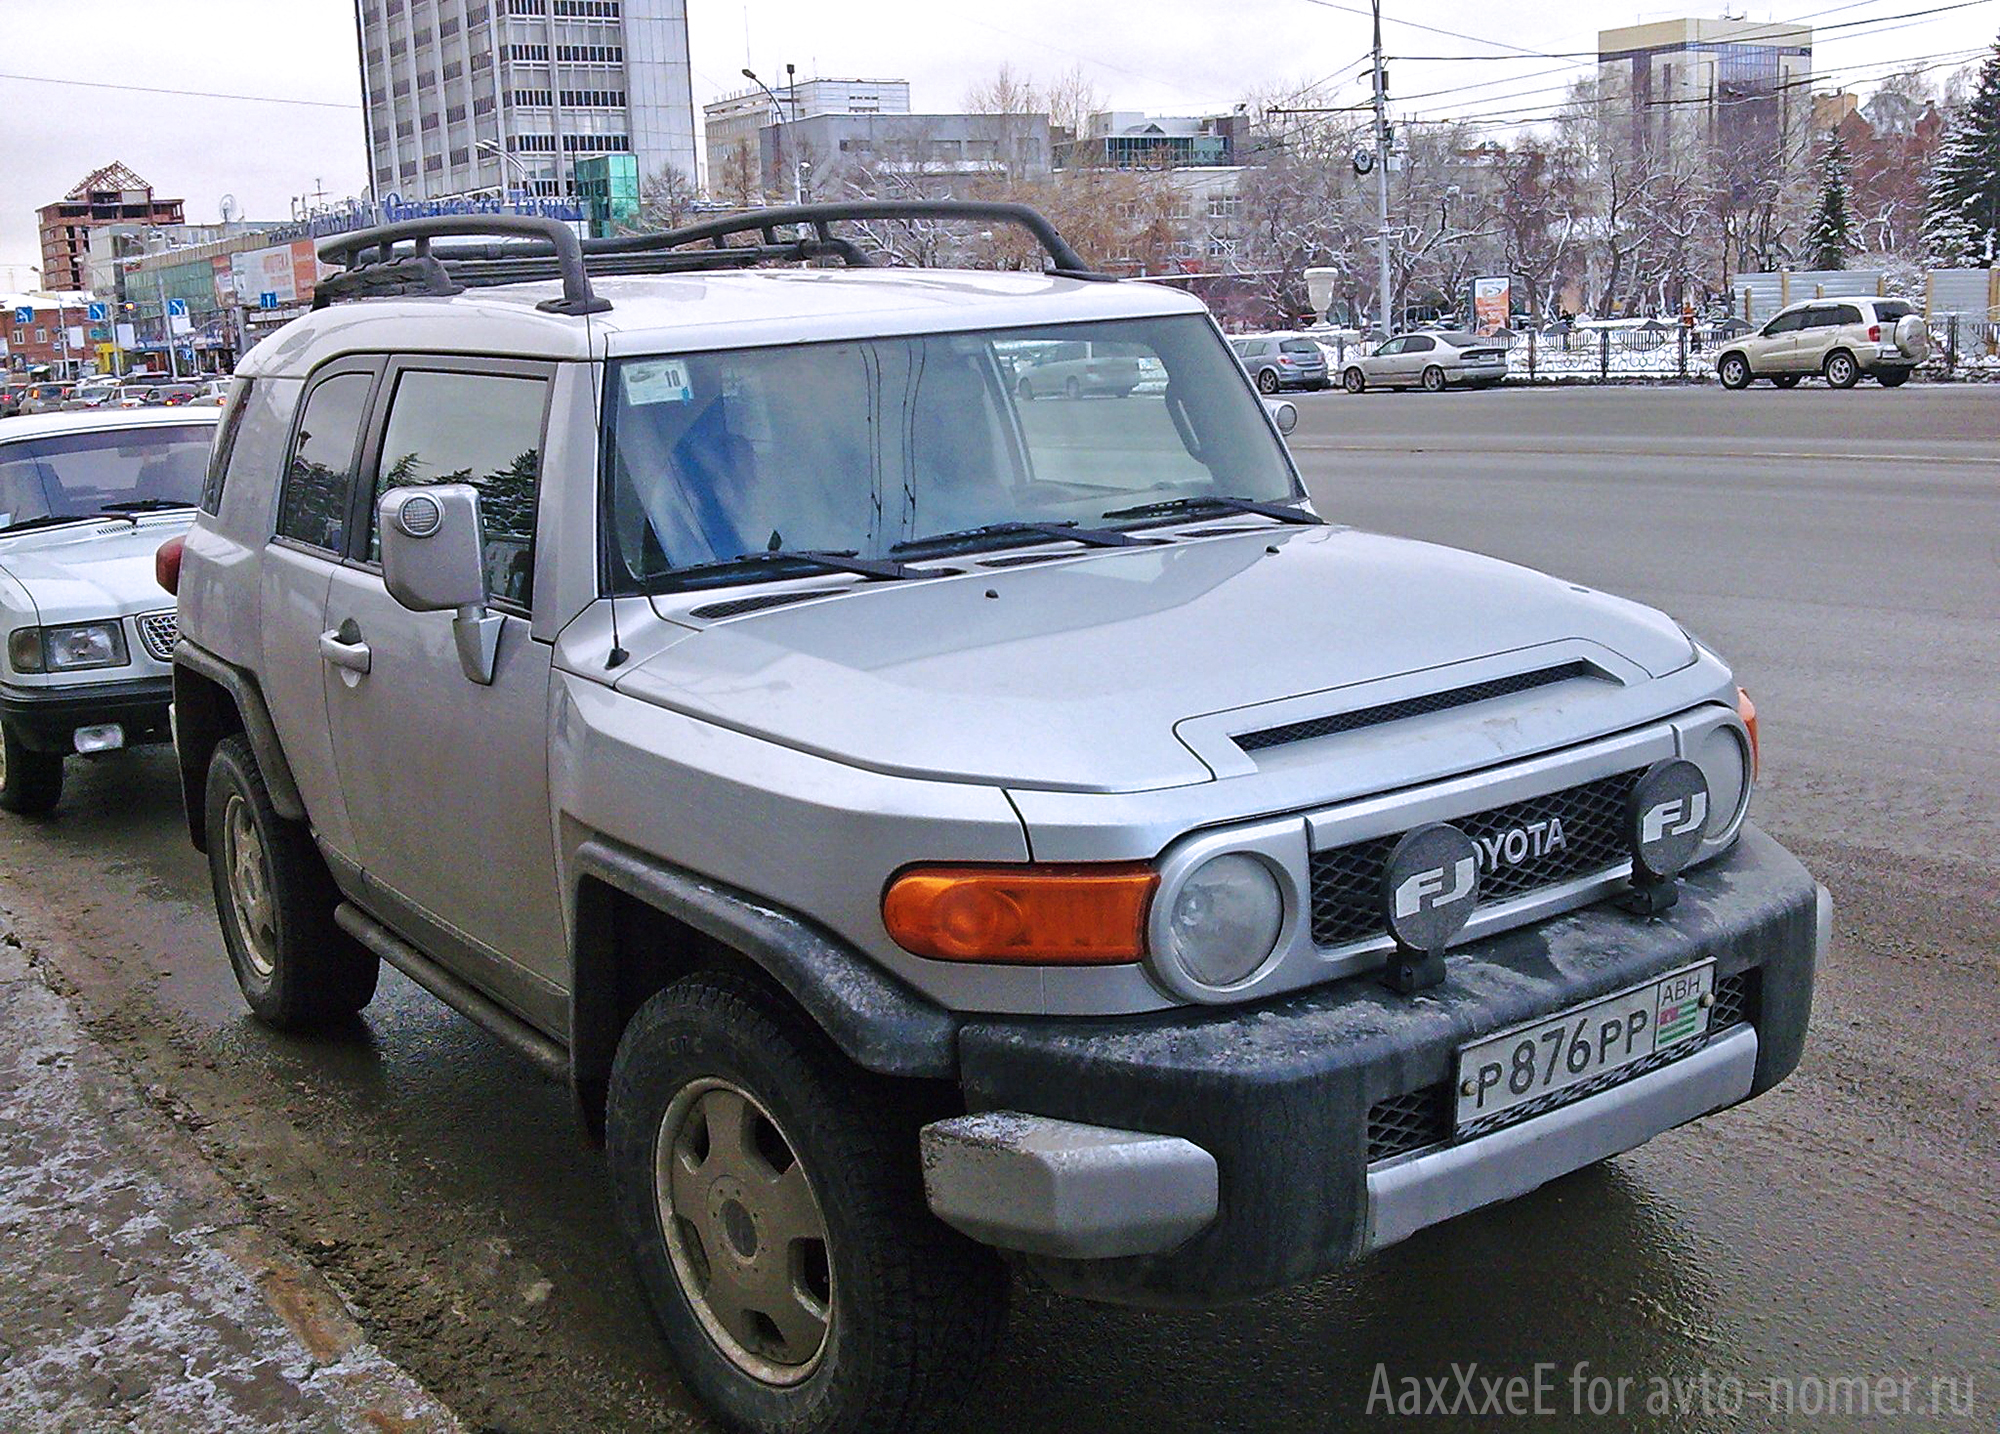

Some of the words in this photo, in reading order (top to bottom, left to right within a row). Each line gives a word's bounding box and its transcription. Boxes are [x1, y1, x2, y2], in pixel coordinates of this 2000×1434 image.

[1643, 792, 1706, 843] FJ
[1471, 818, 1567, 871] YOTA
[1396, 856, 1475, 918] FJ
[1661, 974, 1701, 1006] ABH
